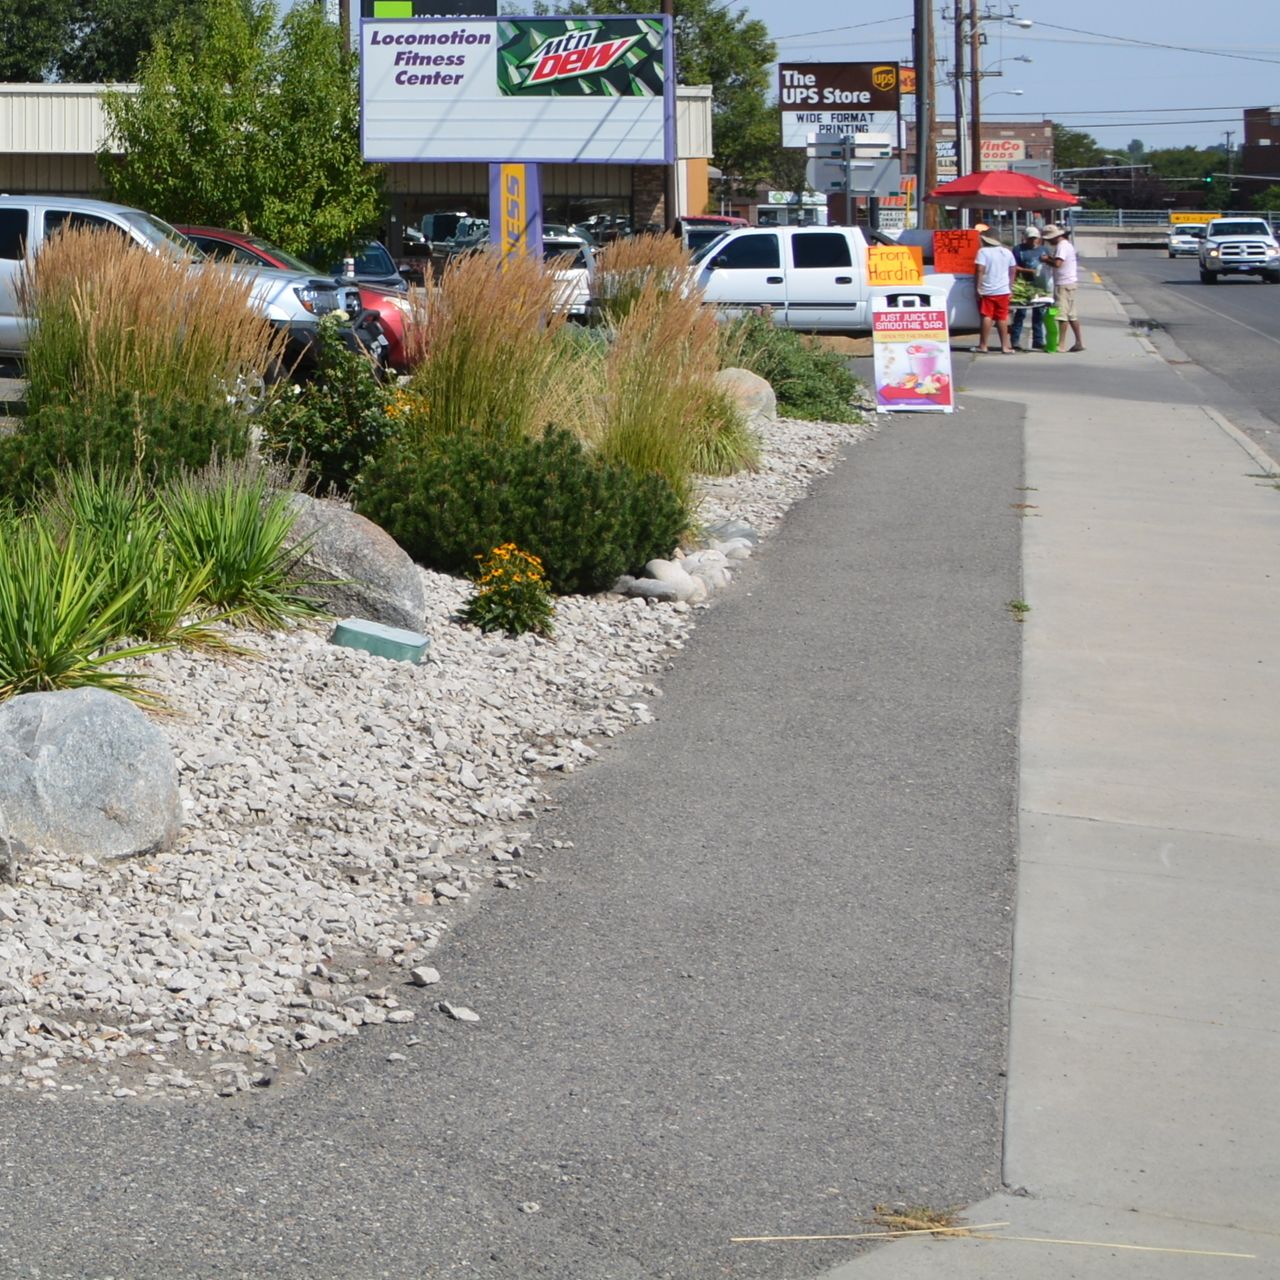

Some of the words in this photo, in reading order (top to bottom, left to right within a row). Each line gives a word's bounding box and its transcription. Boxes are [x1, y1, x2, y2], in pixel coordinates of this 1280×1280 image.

[370, 29, 491, 45] Locomotion
[394, 50, 465, 66] Fitness
[395, 70, 464, 85] Center
[782, 70, 816, 86] The
[782, 88, 819, 104] UPS
[823, 87, 871, 104] Store
[796, 113, 822, 123] WIDE
[831, 113, 875, 123] FORMAT
[818, 124, 869, 134] PRINTING
[868, 248, 911, 261] From
[868, 261, 920, 281] Hardin
[880, 313, 901, 321] JUST
[904, 313, 926, 321] JUICE
[875, 322, 921, 330] SMOOTHIE
[923, 321, 943, 329] BAR
